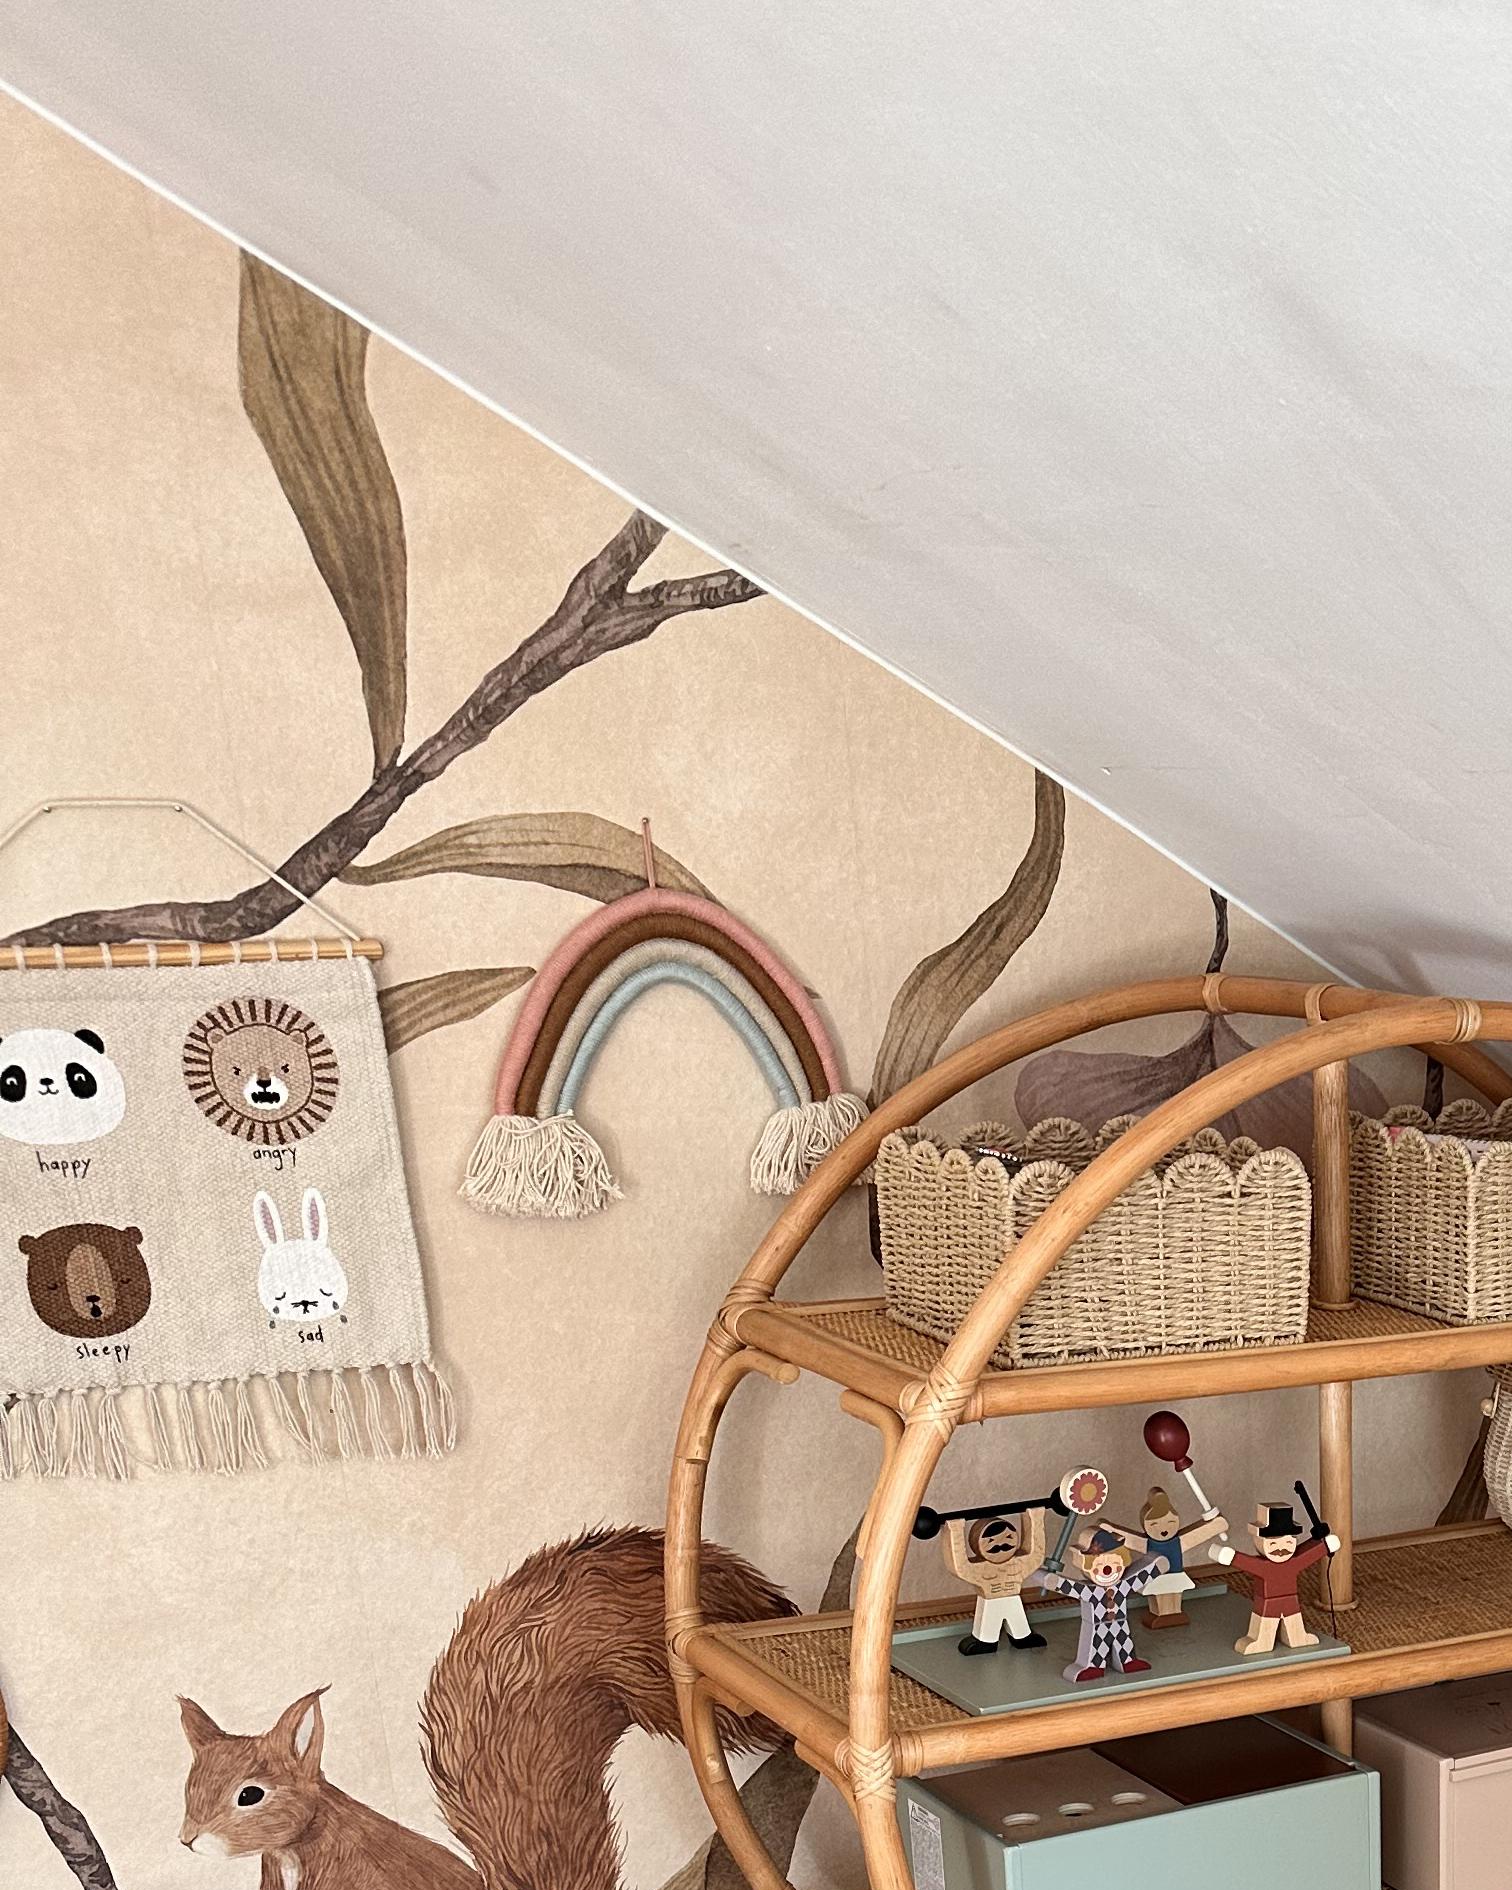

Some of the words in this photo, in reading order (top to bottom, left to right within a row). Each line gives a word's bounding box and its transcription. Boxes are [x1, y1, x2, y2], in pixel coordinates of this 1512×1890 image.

[36, 1151, 91, 1179] happy
[253, 1148, 296, 1171] angry
[298, 1324, 324, 1343] sad
[76, 1343, 130, 1363] sleepy
